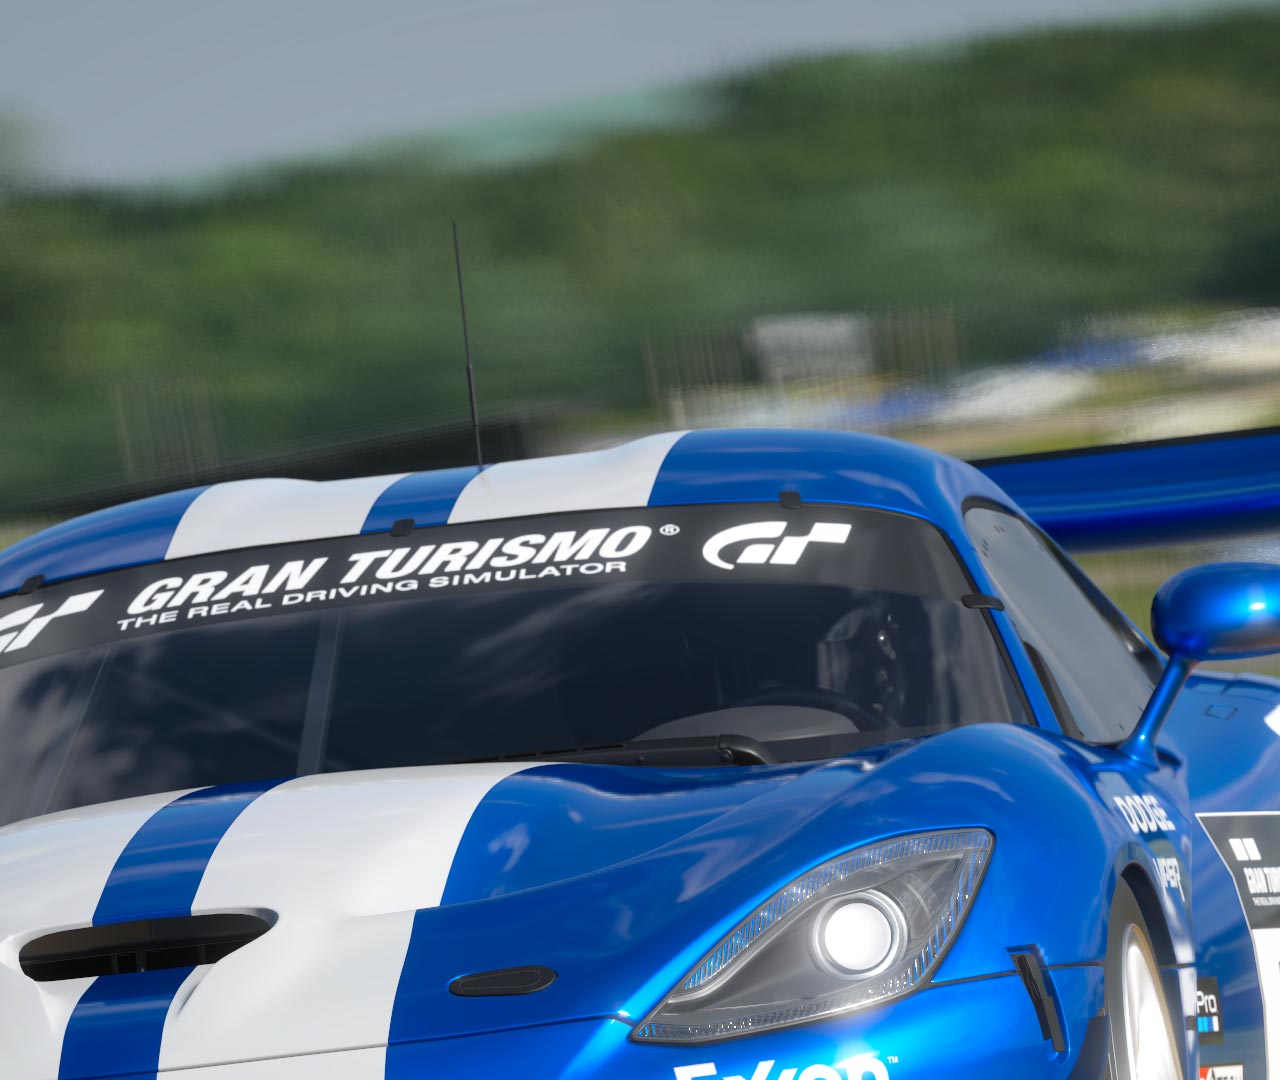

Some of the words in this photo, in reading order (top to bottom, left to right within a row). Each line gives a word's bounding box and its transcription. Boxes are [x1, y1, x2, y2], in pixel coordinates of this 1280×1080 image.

[117, 610, 178, 631] THE
[187, 598, 273, 620] REAL
[282, 579, 418, 606] DRIVING
[429, 561, 627, 588] SIMULATOR
[126, 557, 328, 615] GRAN
[1113, 795, 1176, 834] DODGE
